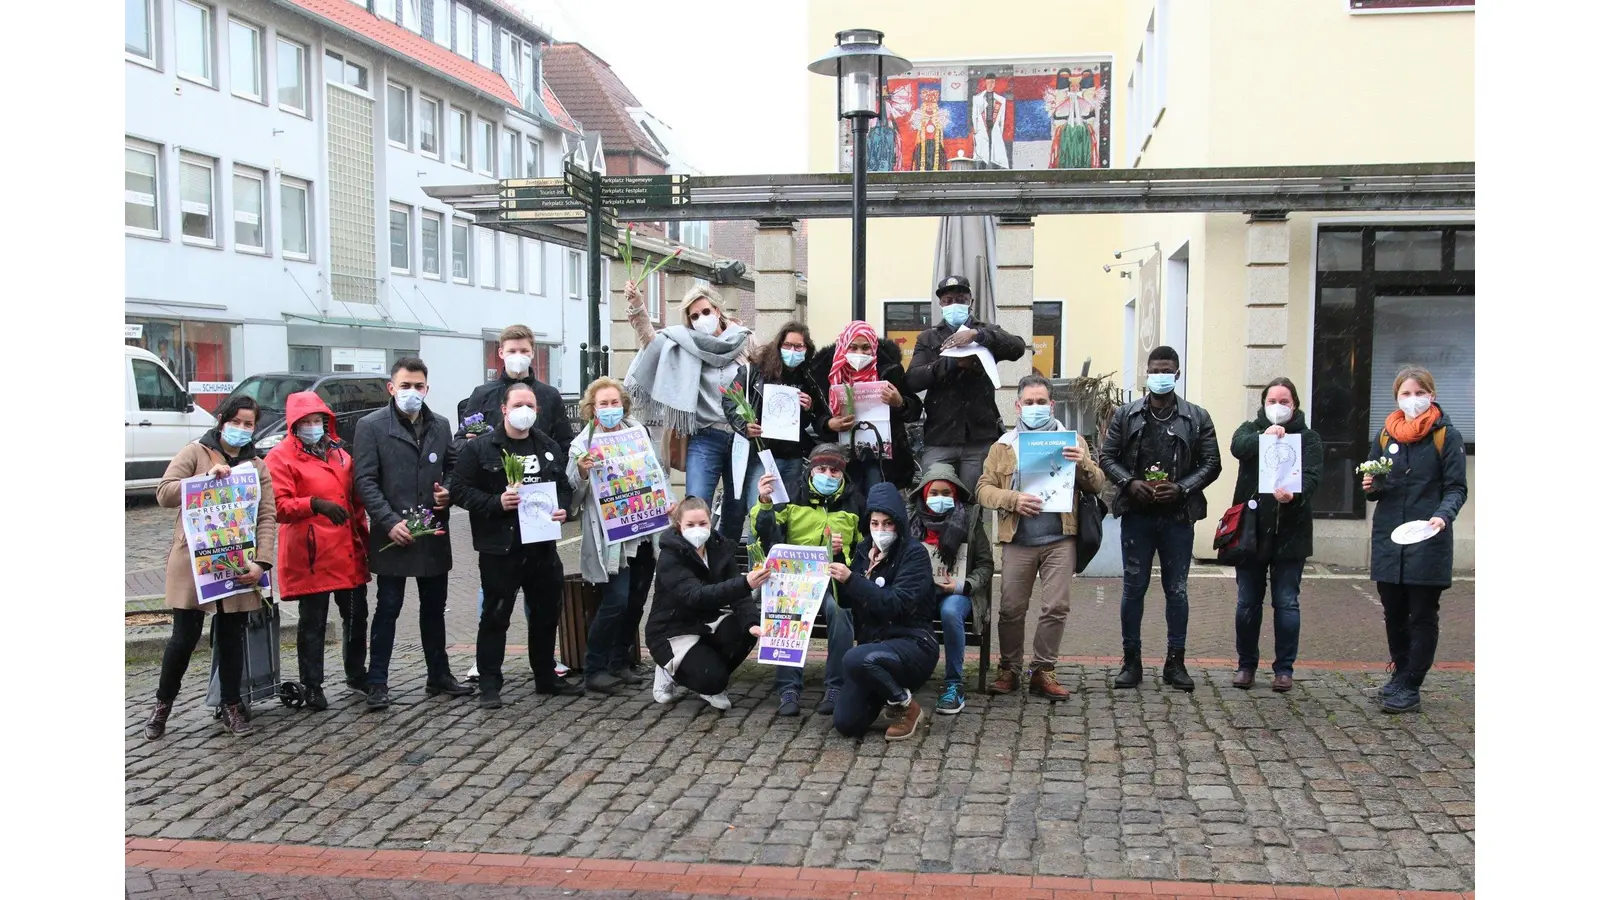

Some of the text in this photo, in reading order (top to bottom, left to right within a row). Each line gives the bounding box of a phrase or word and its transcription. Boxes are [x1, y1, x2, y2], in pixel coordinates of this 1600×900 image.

[625, 176, 654, 184] Hagemeyer
[202, 384, 235, 392] SCHUHPARK
[598, 432, 641, 446] ACHTUNG
[202, 475, 255, 491] ACHTUNG
[603, 496, 615, 504] VON
[614, 492, 635, 502] MENSCH
[620, 506, 667, 525] MENSCH!
[212, 545, 235, 555] MENSCH
[776, 550, 825, 560] ACHTUNG
[769, 638, 805, 648] MENSCH!
